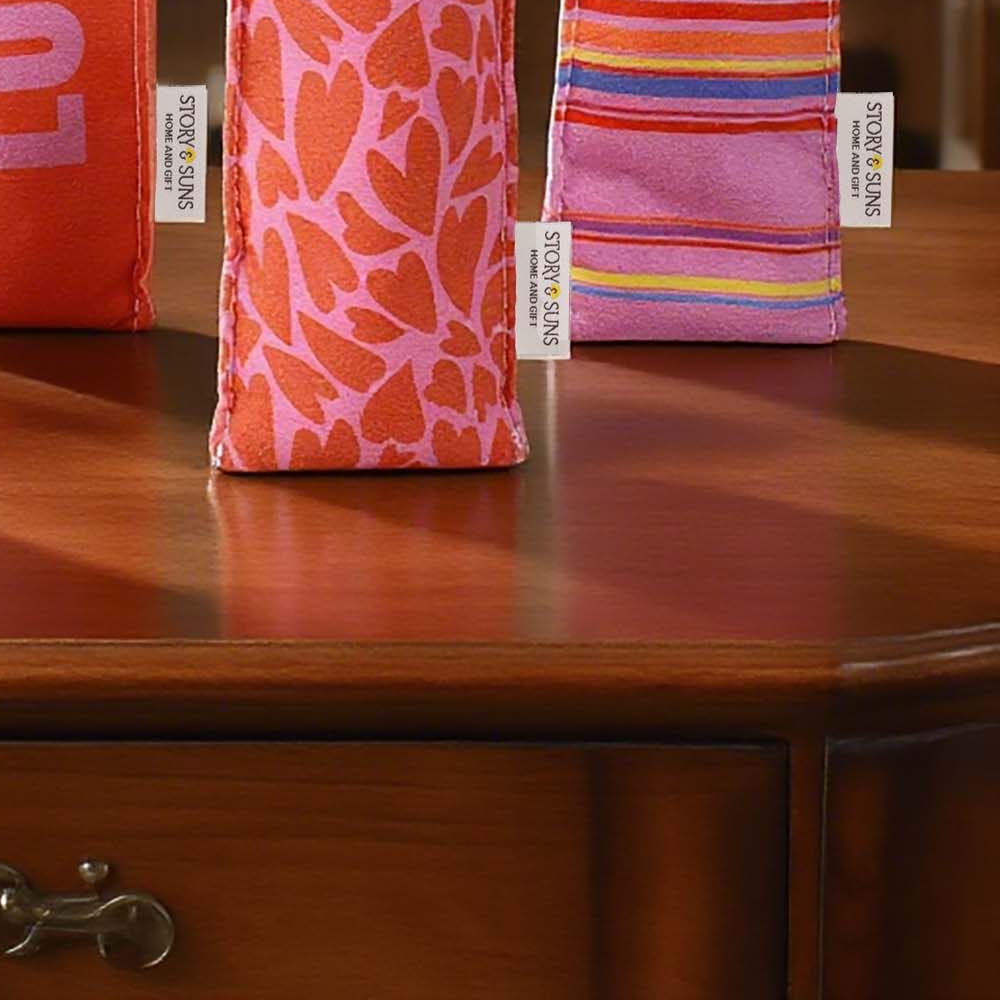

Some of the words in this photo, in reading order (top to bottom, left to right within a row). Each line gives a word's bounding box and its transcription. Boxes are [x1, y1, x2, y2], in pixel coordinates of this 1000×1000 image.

[164, 113, 173, 143] HOME
[177, 94, 195, 148] STORY
[851, 120, 860, 149] HOME
[864, 102, 882, 154] STORY
[164, 145, 173, 168] AND
[851, 152, 860, 175] AND
[164, 169, 172, 191] GIFT
[178, 165, 194, 210] SUNS
[851, 176, 859, 198] GIFT
[865, 172, 881, 217] SUNS
[529, 249, 538, 279] HOME
[542, 231, 560, 284] STORY
[529, 281, 538, 304] AND
[529, 305, 537, 327] GIFT
[543, 301, 559, 346] SUNS
